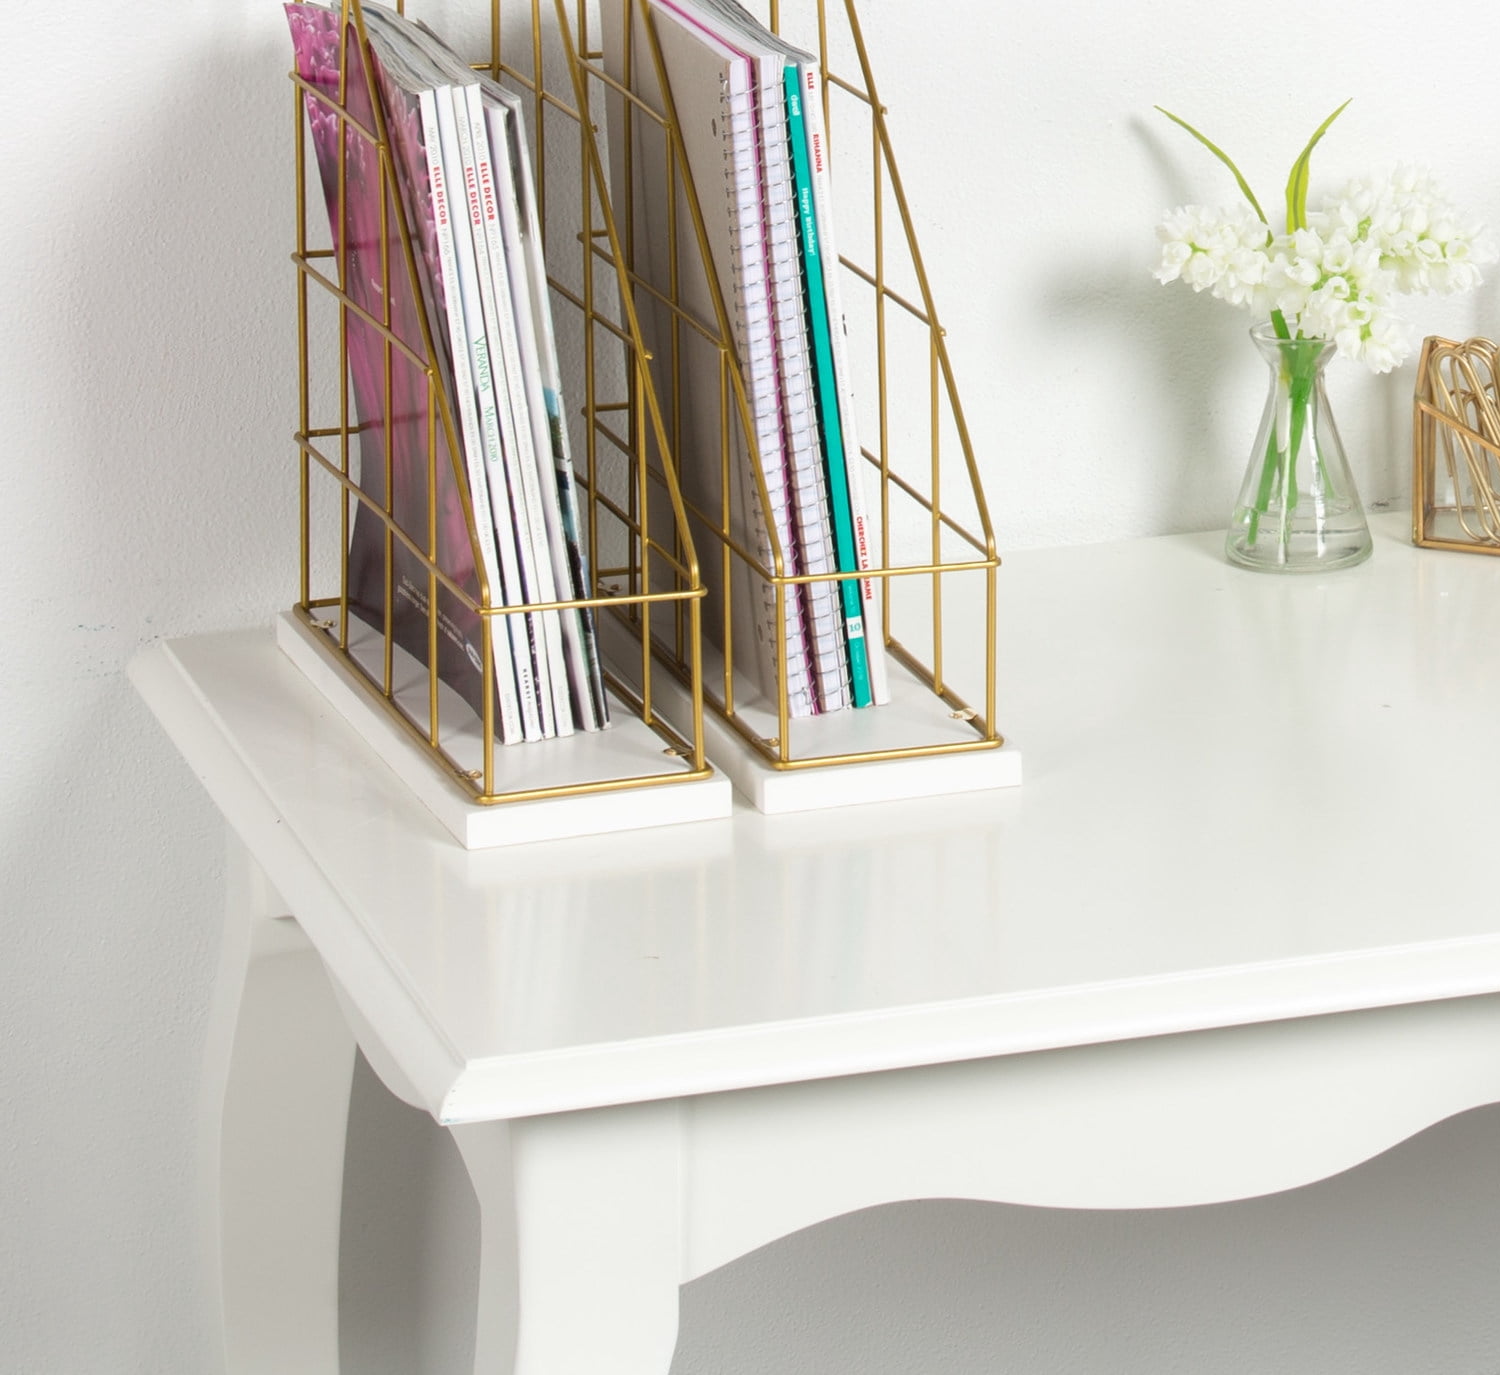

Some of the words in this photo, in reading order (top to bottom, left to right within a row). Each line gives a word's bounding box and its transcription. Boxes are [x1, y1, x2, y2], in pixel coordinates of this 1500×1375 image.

[806, 72, 815, 90] ELLE
[813, 133, 823, 174] RIHANNA
[434, 166, 443, 188] ELLE
[466, 167, 476, 190] ELLE
[480, 162, 490, 184] ELLE
[437, 191, 448, 226] DECOR
[470, 191, 481, 226] DECOR
[484, 186, 495, 221] DECOR
[801, 187, 810, 215] Happy
[856, 516, 867, 558] CHERCHEZ
[861, 559, 869, 570] LA
